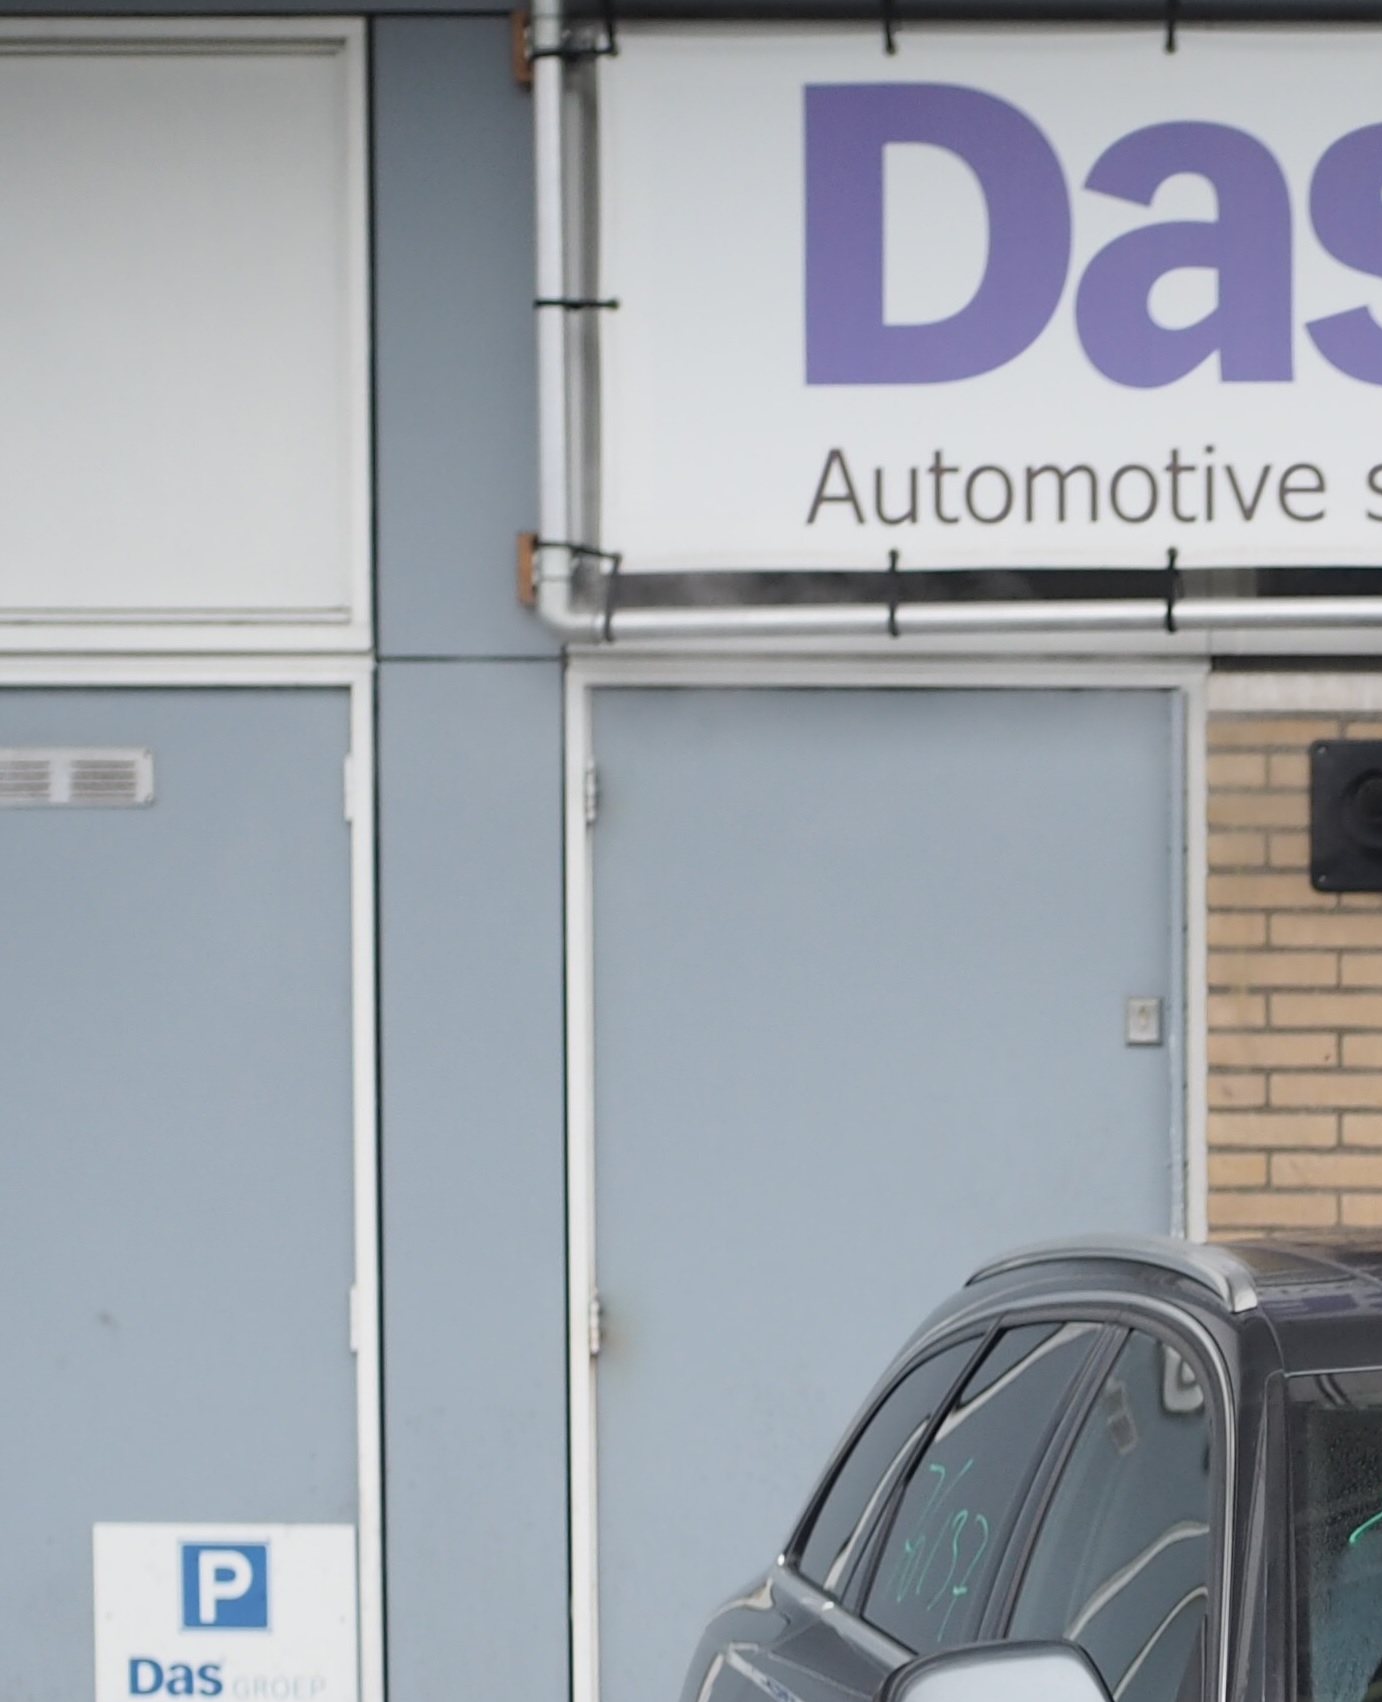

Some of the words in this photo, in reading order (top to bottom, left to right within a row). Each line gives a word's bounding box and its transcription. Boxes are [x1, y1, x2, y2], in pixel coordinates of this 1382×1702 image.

[806, 445, 1326, 526] Automotive
[198, 1549, 253, 1625] P
[128, 1656, 223, 1697] Das
